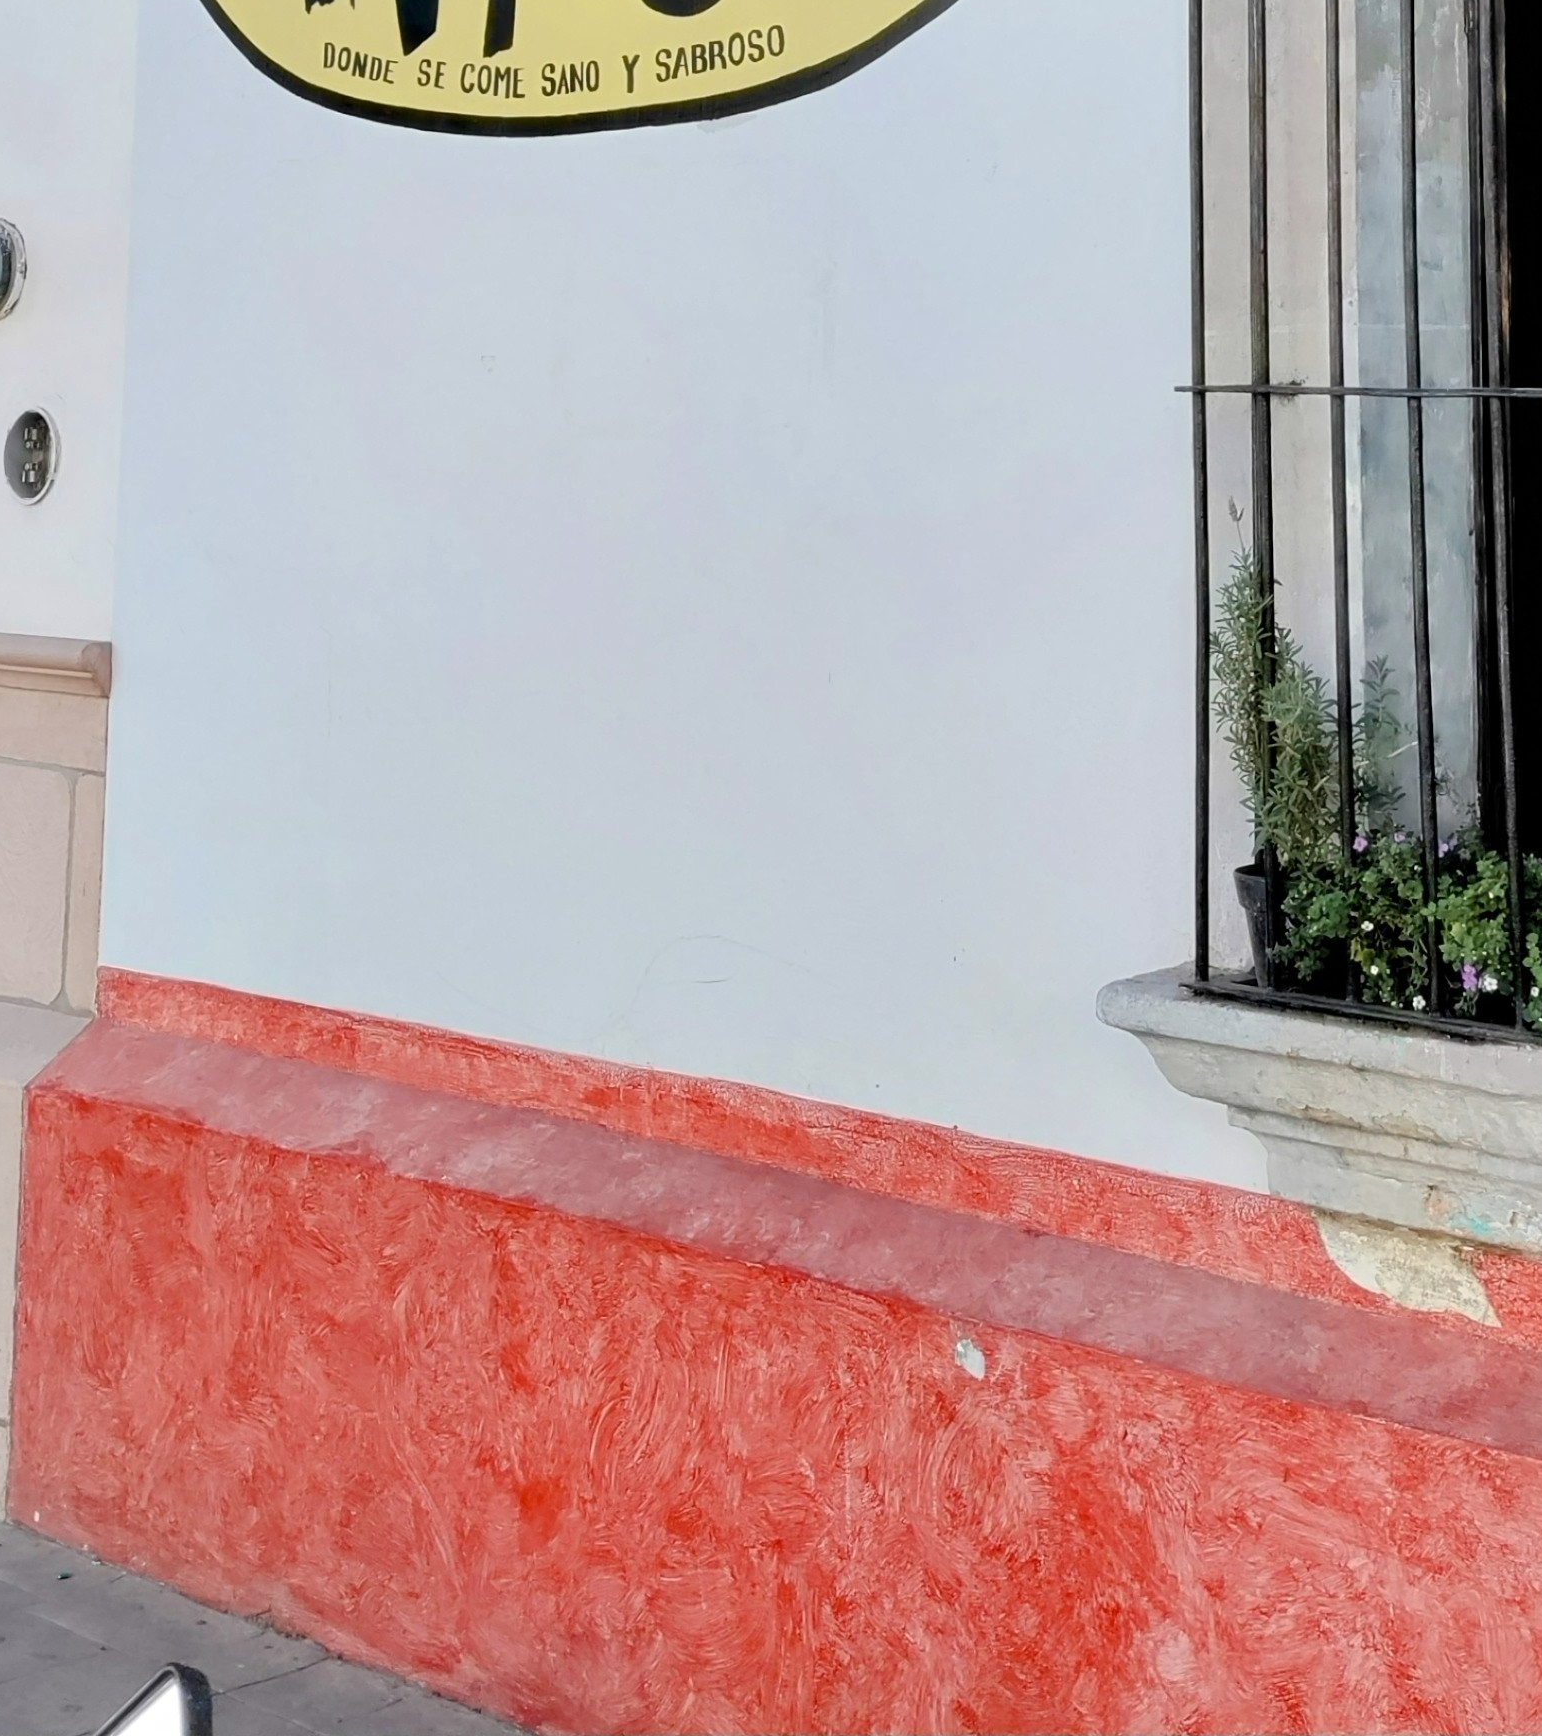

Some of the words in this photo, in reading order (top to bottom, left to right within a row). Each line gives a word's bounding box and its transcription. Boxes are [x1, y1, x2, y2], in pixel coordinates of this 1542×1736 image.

[323, 42, 399, 84] DONDE
[416, 59, 446, 90] SE
[460, 63, 526, 99] COME
[540, 60, 601, 96] SANO
[622, 54, 641, 94] Y
[655, 24, 786, 83] SABROSO
